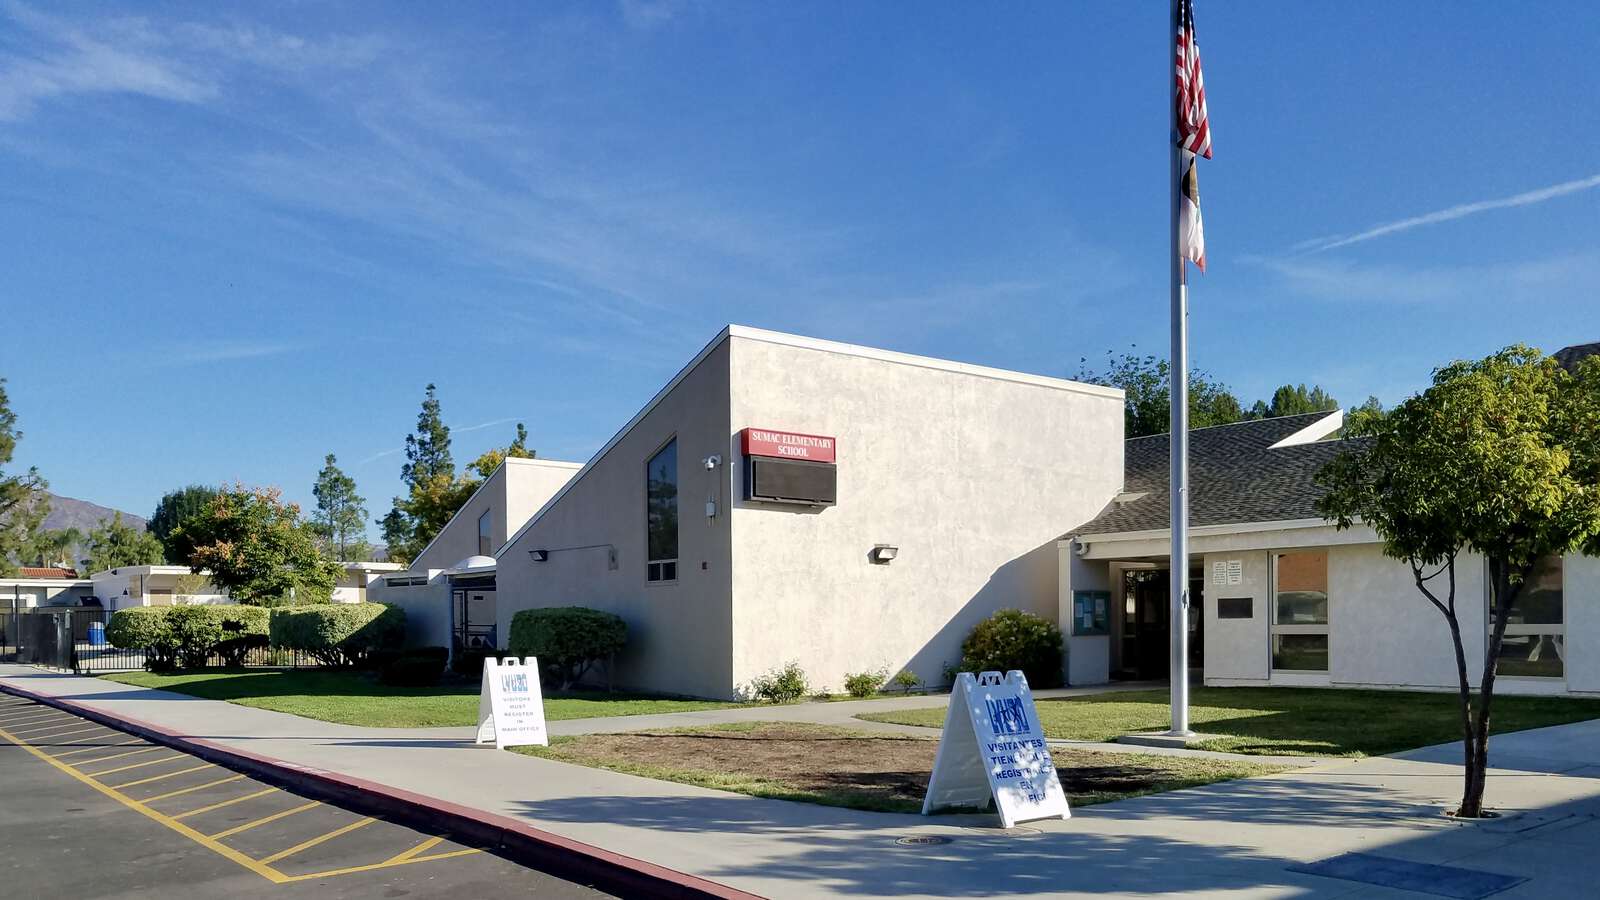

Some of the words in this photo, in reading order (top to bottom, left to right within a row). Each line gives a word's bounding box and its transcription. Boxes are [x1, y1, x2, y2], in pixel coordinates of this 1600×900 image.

[752, 431, 780, 442] SUMAC
[782, 435, 832, 448] ELEMENTARY
[778, 446, 808, 456] SCHOOL
[987, 739, 1043, 752] VISITANTES
